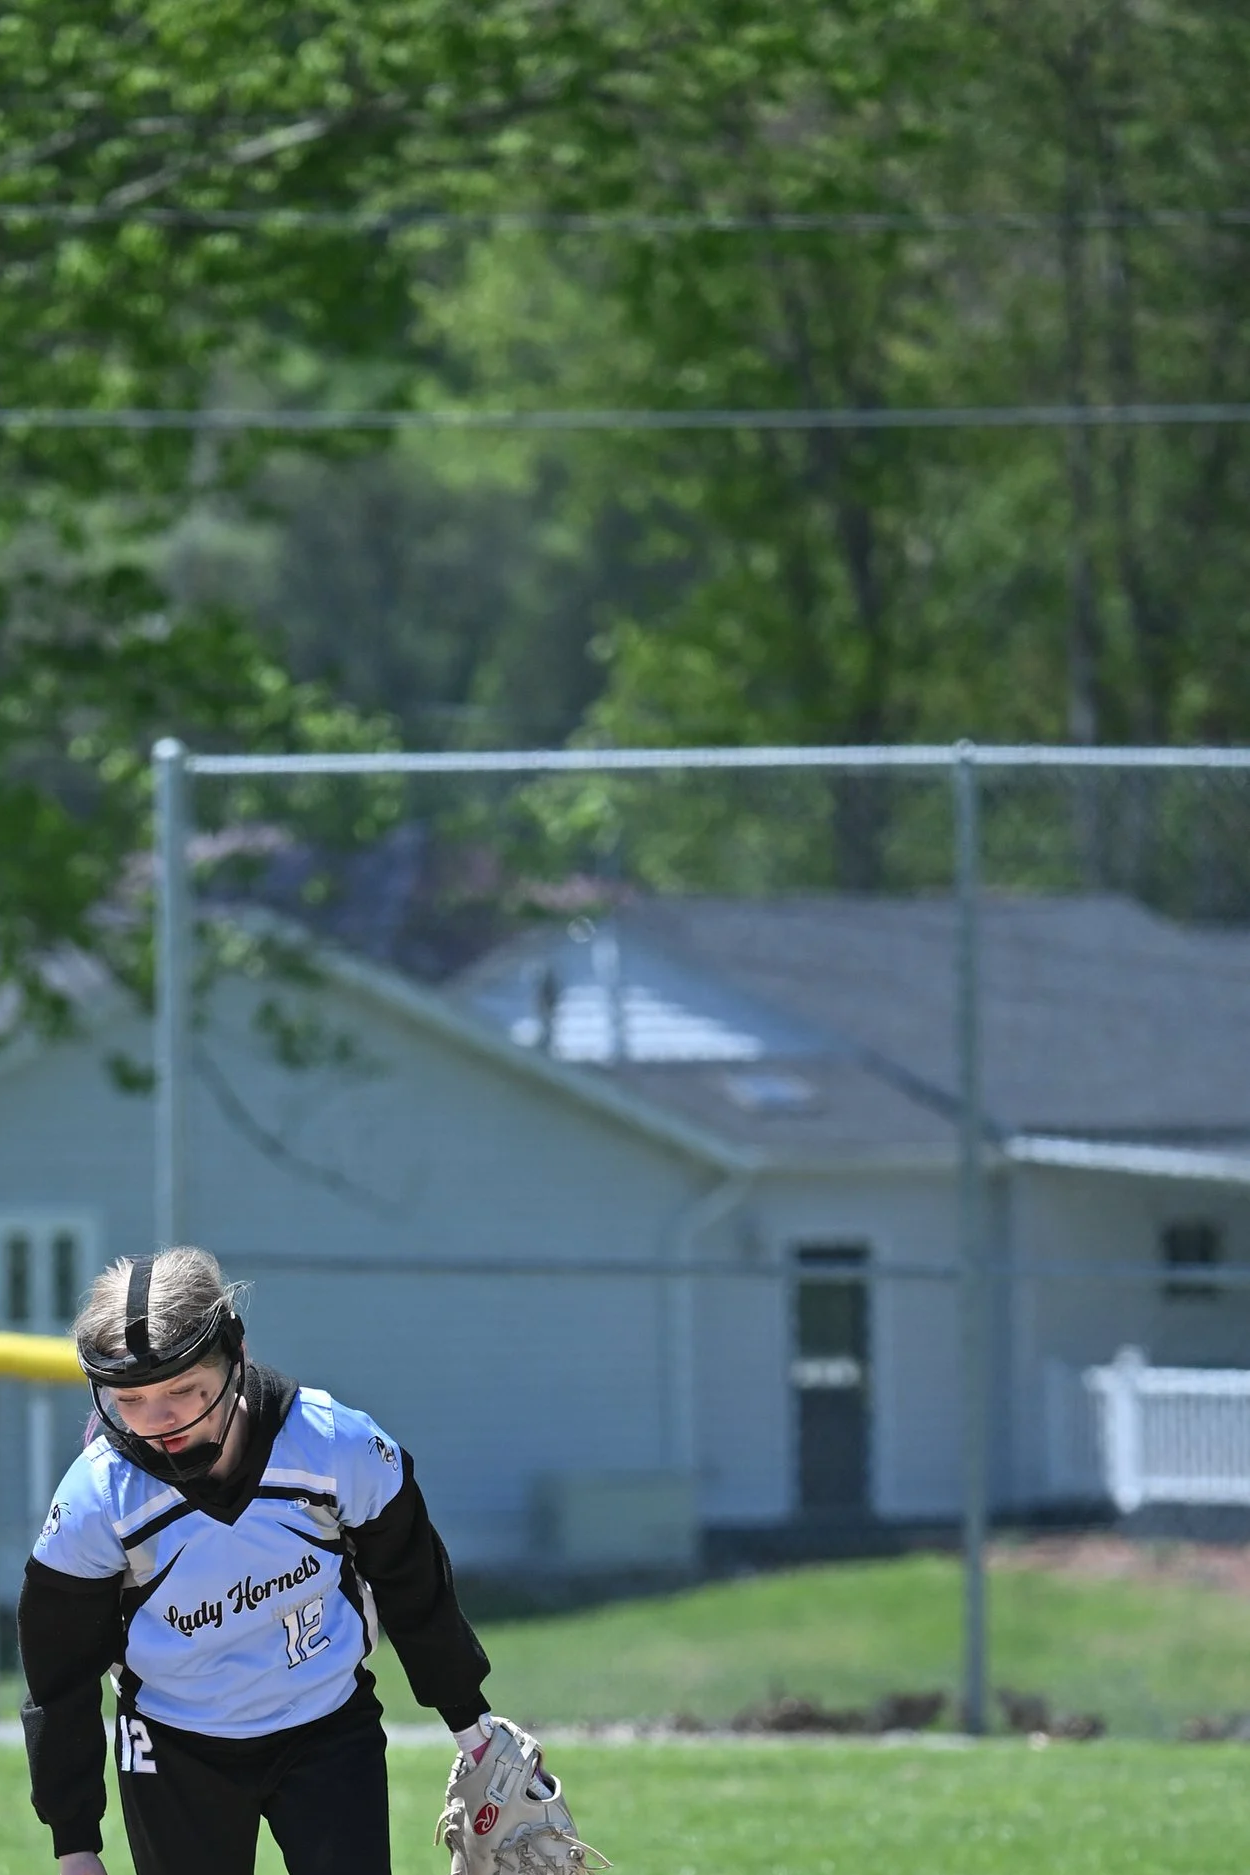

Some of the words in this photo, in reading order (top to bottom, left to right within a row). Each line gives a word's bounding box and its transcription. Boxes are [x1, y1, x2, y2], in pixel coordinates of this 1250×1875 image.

[163, 1600, 224, 1637] Lady
[227, 1554, 321, 1613] Hornets
[282, 1597, 331, 1670] 12
[120, 1714, 157, 1774] 12
